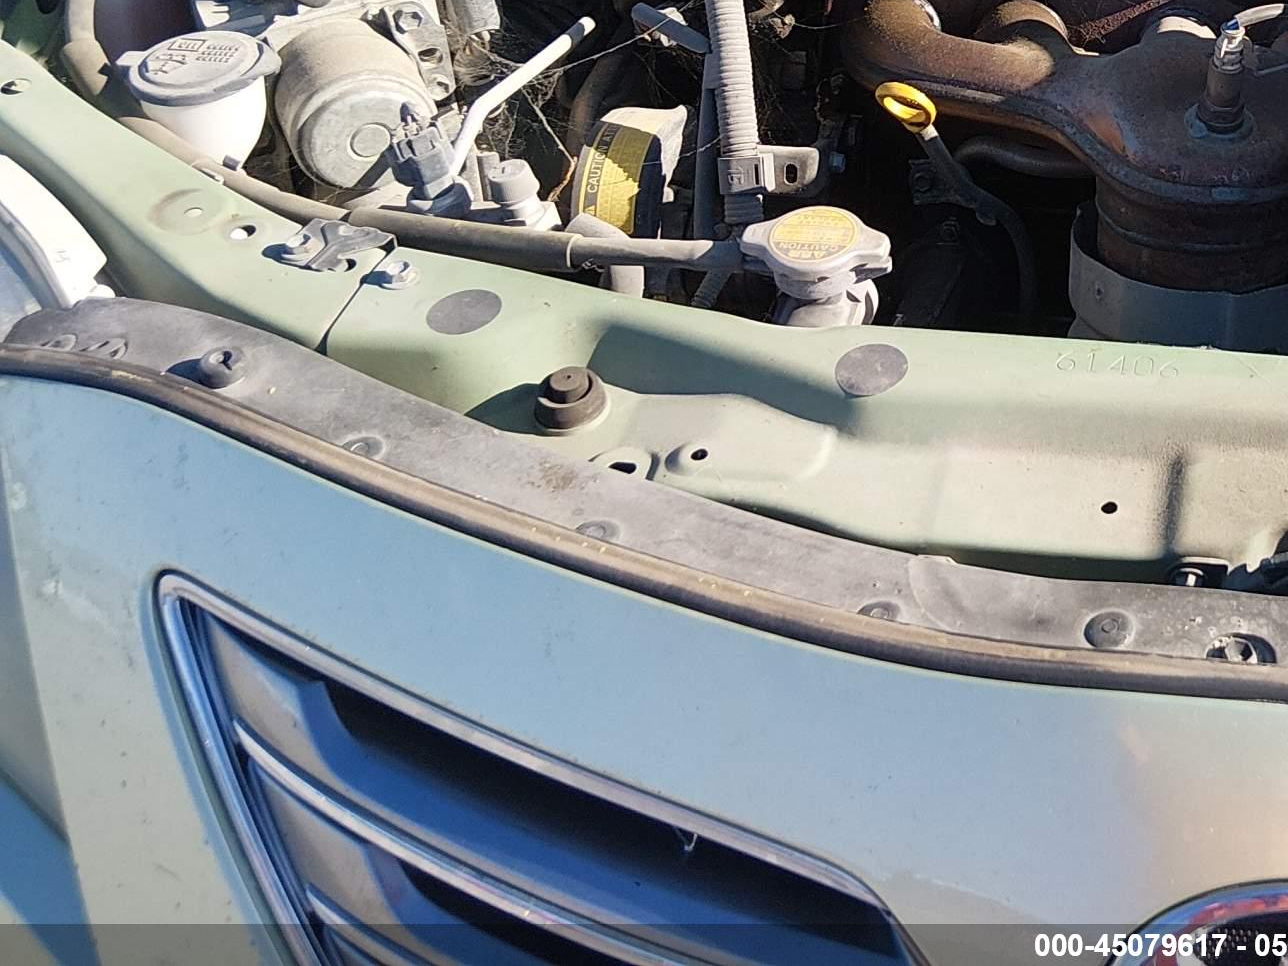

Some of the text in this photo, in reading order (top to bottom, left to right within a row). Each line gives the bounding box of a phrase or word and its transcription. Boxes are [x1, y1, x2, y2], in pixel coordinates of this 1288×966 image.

[586, 144, 609, 194] CAUTION
[779, 241, 840, 252] CAUTION
[1056, 351, 1179, 379] 61406
